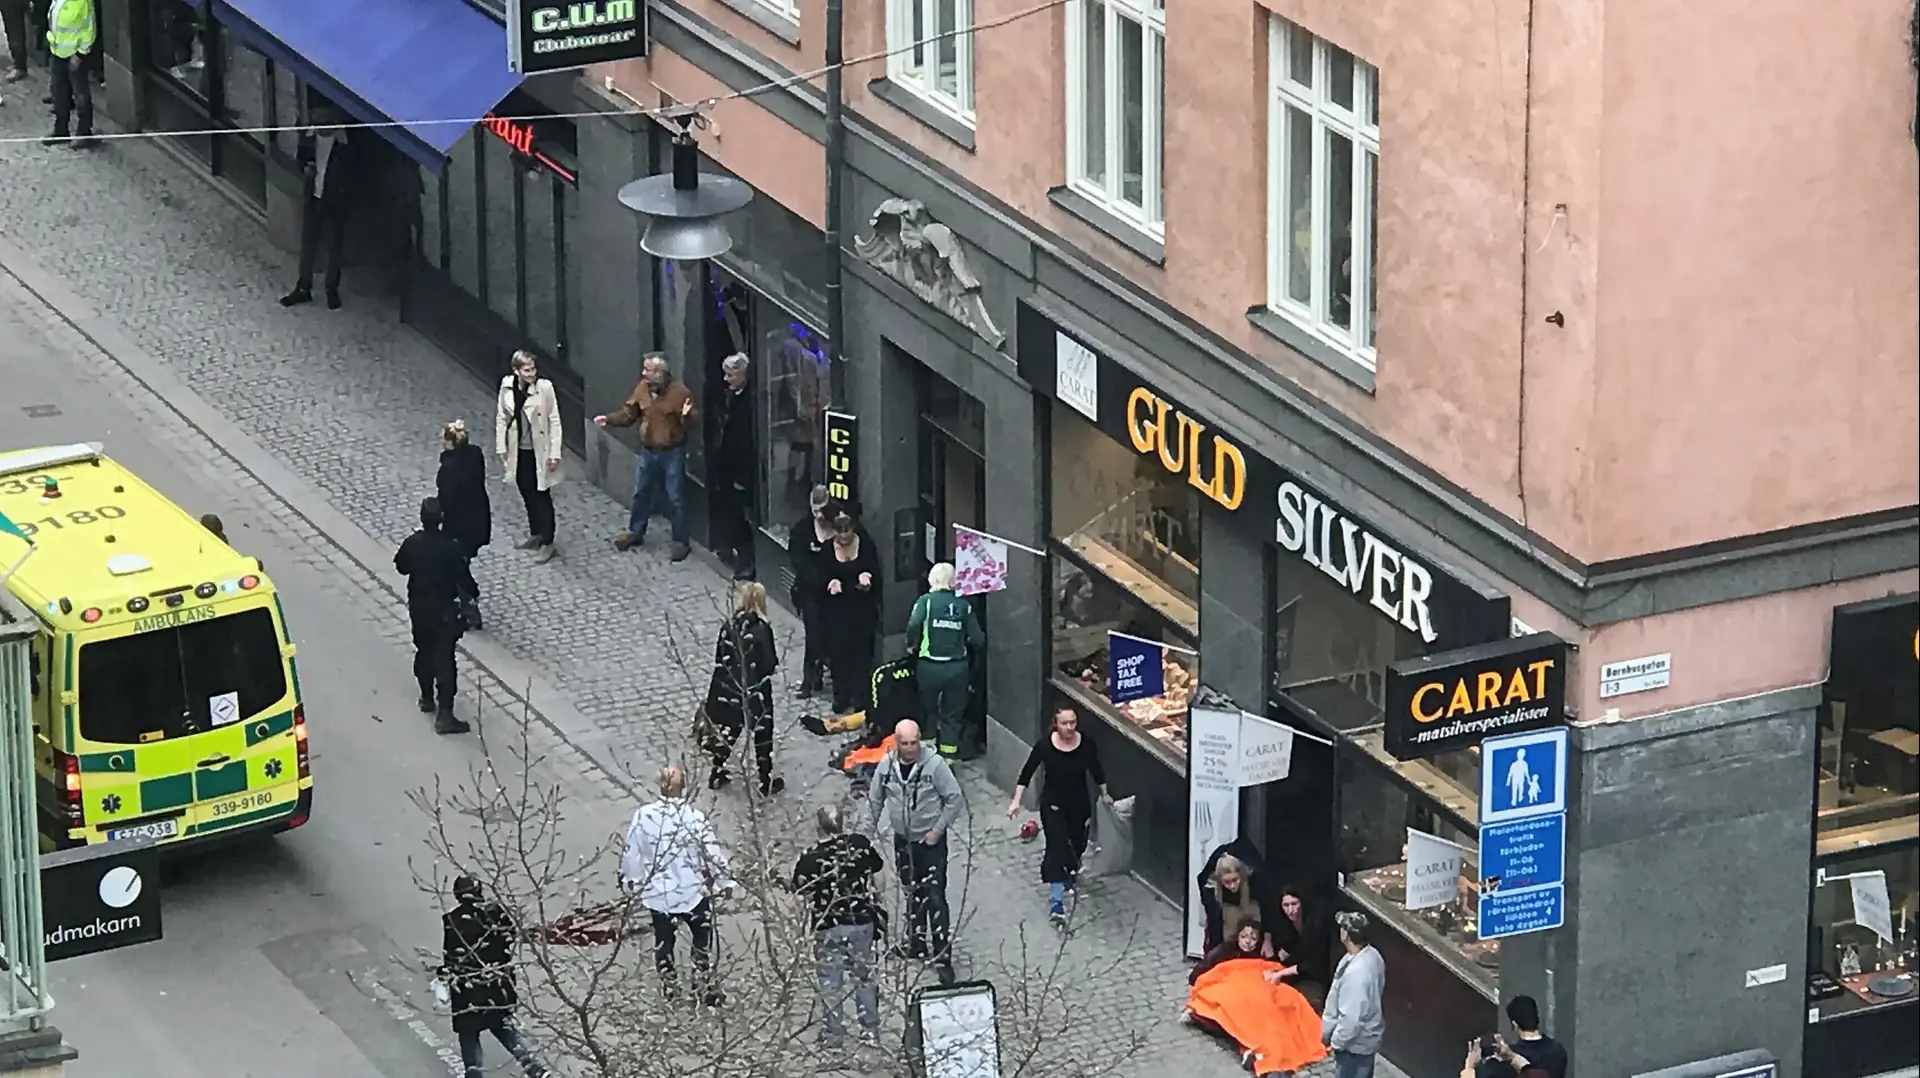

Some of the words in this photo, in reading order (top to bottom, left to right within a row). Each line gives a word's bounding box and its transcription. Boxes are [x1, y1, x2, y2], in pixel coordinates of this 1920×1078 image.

[533, 29, 636, 53] Clubwear
[1060, 371, 1095, 407] CARAT
[1127, 386, 1247, 511] GULD
[1276, 481, 1438, 643] SILVER
[133, 604, 216, 632] AMBULANS
[1117, 654, 1145, 669] SHOP
[1117, 666, 1137, 679] TAX
[1117, 675, 1143, 690] FREE
[1410, 659, 1555, 723] CARAT
[1245, 741, 1285, 757] CARAT
[212, 792, 273, 816] 339-9180
[147, 822, 172, 835] 938
[1415, 859, 1454, 877] CARAT
[43, 915, 141, 947] udmakarn
